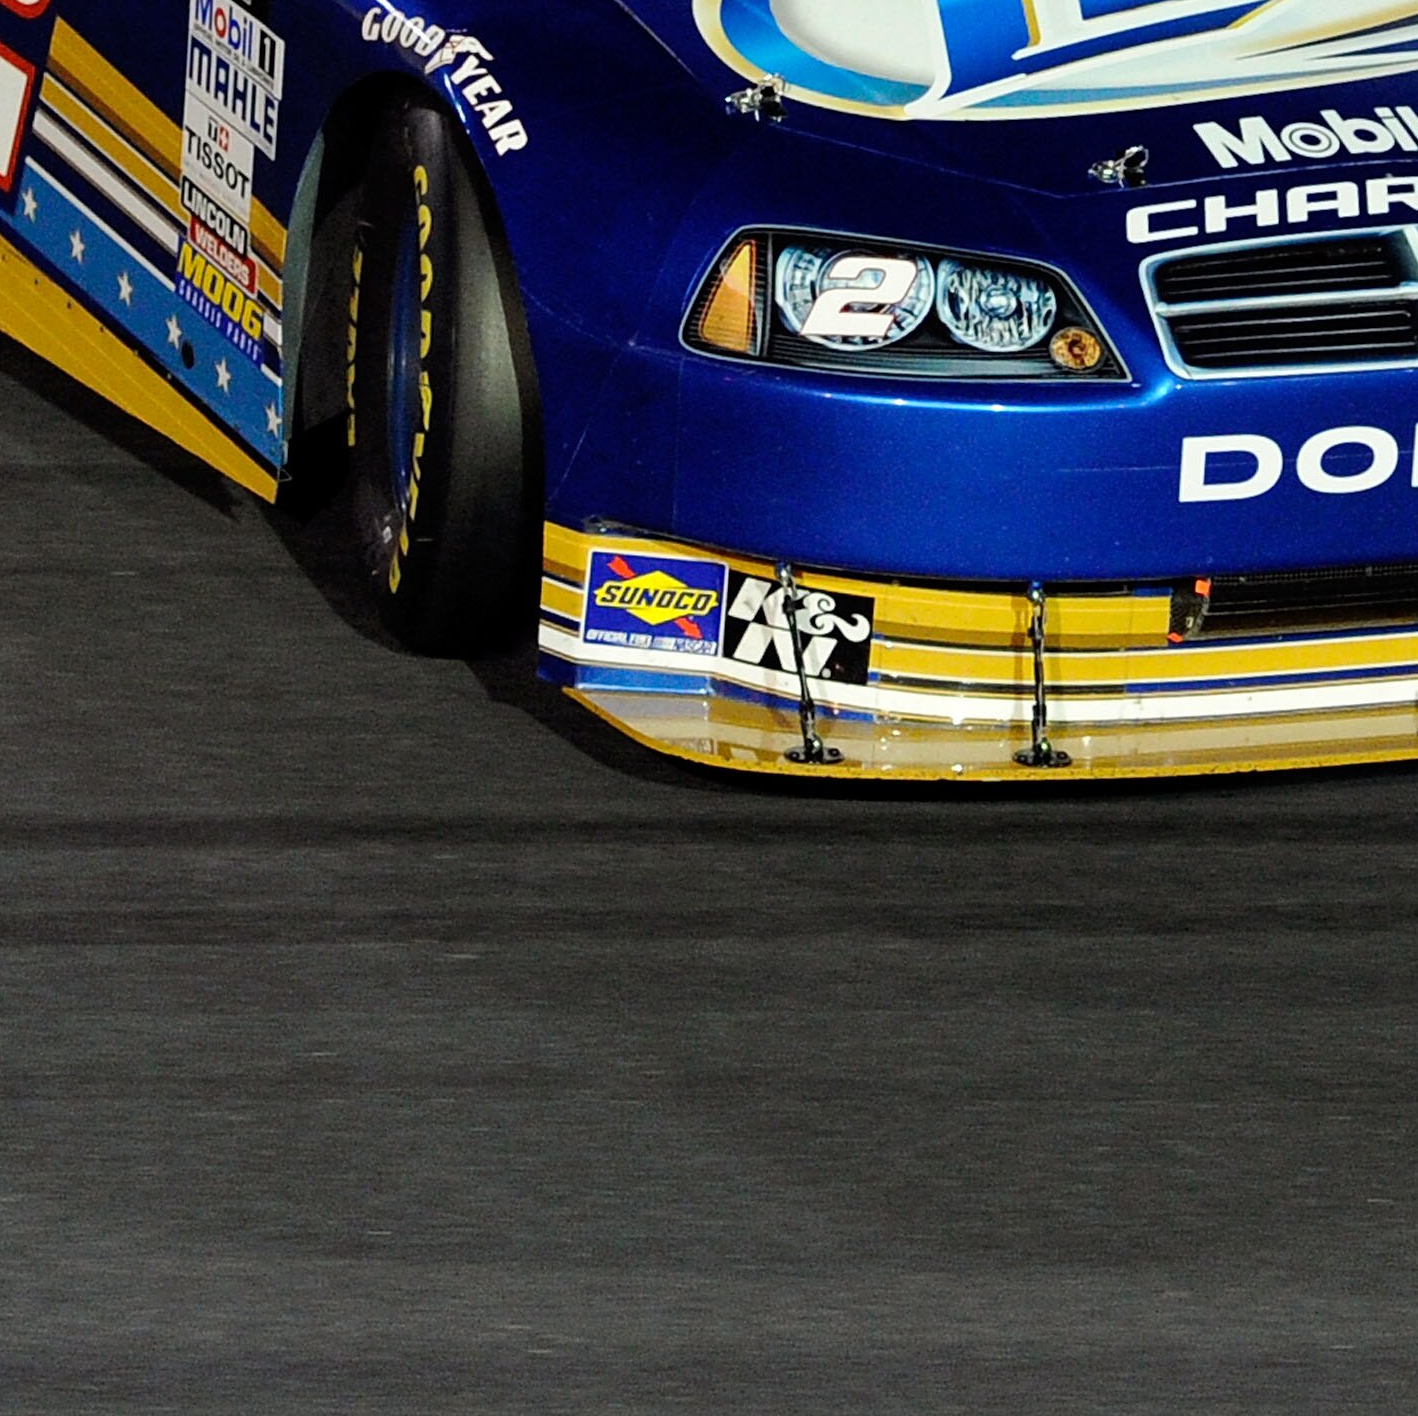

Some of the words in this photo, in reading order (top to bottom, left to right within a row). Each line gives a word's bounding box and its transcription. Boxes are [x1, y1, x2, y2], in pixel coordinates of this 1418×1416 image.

[188, 34, 276, 146] MAHLE
[184, 125, 250, 200] TISSOT
[183, 181, 246, 256] LINCOLN
[193, 222, 250, 287] WELDERS
[178, 240, 265, 341] MOOG
[800, 255, 919, 337] 2
[600, 583, 713, 612] SUNOCO
